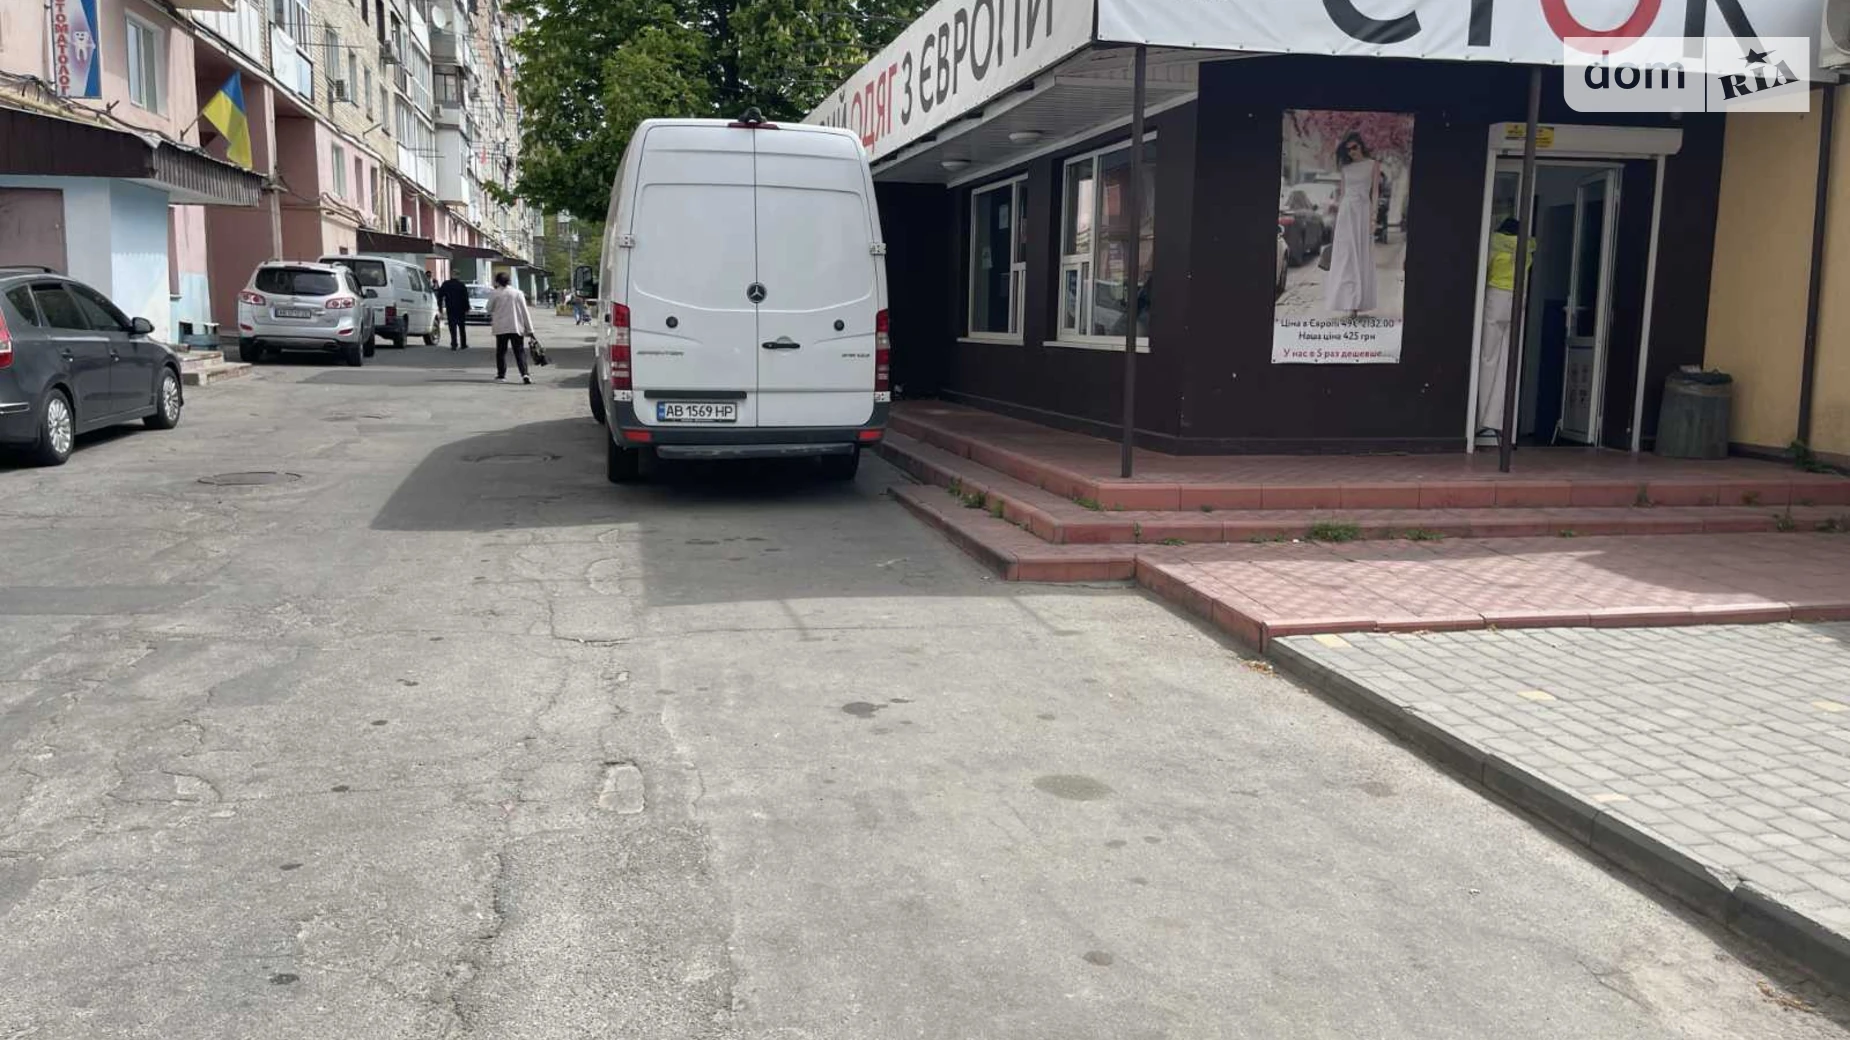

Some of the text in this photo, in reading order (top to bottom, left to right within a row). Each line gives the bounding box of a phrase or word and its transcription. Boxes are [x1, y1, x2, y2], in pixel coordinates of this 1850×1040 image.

[55, 0, 69, 96] ТОМАТОЛОГ
[851, 62, 897, 154] ОДЯГ
[901, 51, 912, 125] З
[1281, 318, 1301, 327] Ціна
[1299, 332, 1321, 340] Наша
[1323, 332, 1341, 341] ціна
[1343, 331, 1359, 340] 425
[1283, 348, 1290, 357] У
[1325, 351, 1340, 359] раз
[666, 405, 733, 417] AB 1569 HP
